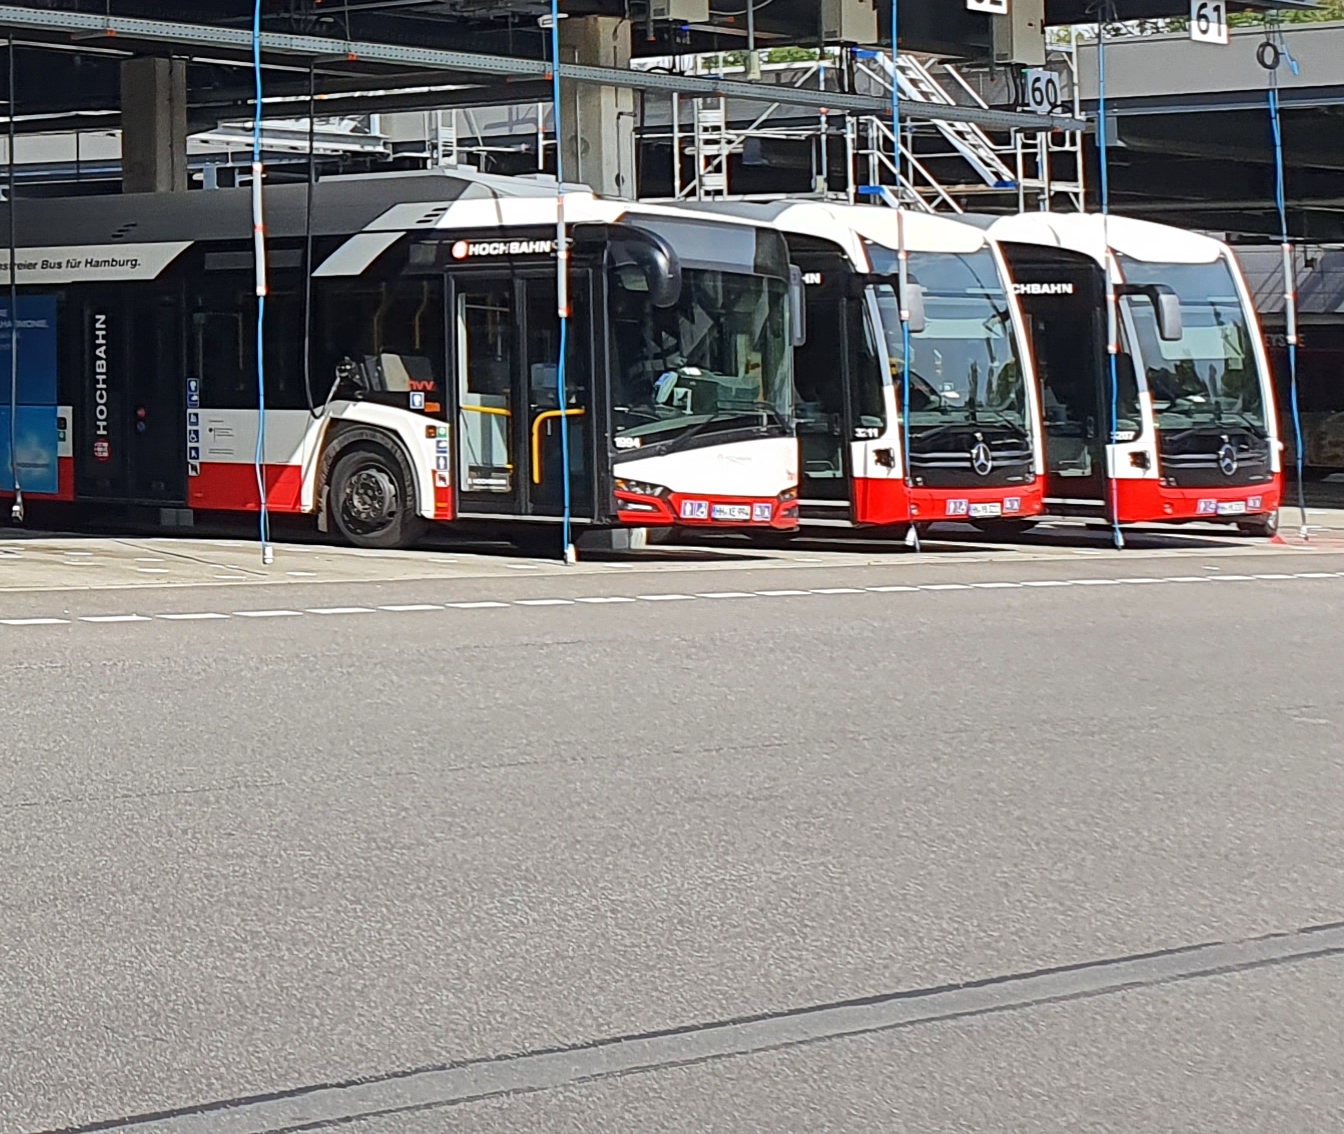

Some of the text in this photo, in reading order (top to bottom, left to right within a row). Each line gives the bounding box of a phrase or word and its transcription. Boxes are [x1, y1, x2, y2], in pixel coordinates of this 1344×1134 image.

[1196, 2, 1222, 37] 61
[1031, 76, 1058, 108] 60
[41, 259, 62, 270] Bus
[66, 257, 82, 269] für
[84, 257, 141, 270] Hamburg.
[468, 240, 551, 256] HOCHBAHN
[95, 314, 108, 435] HOCHBAHN
